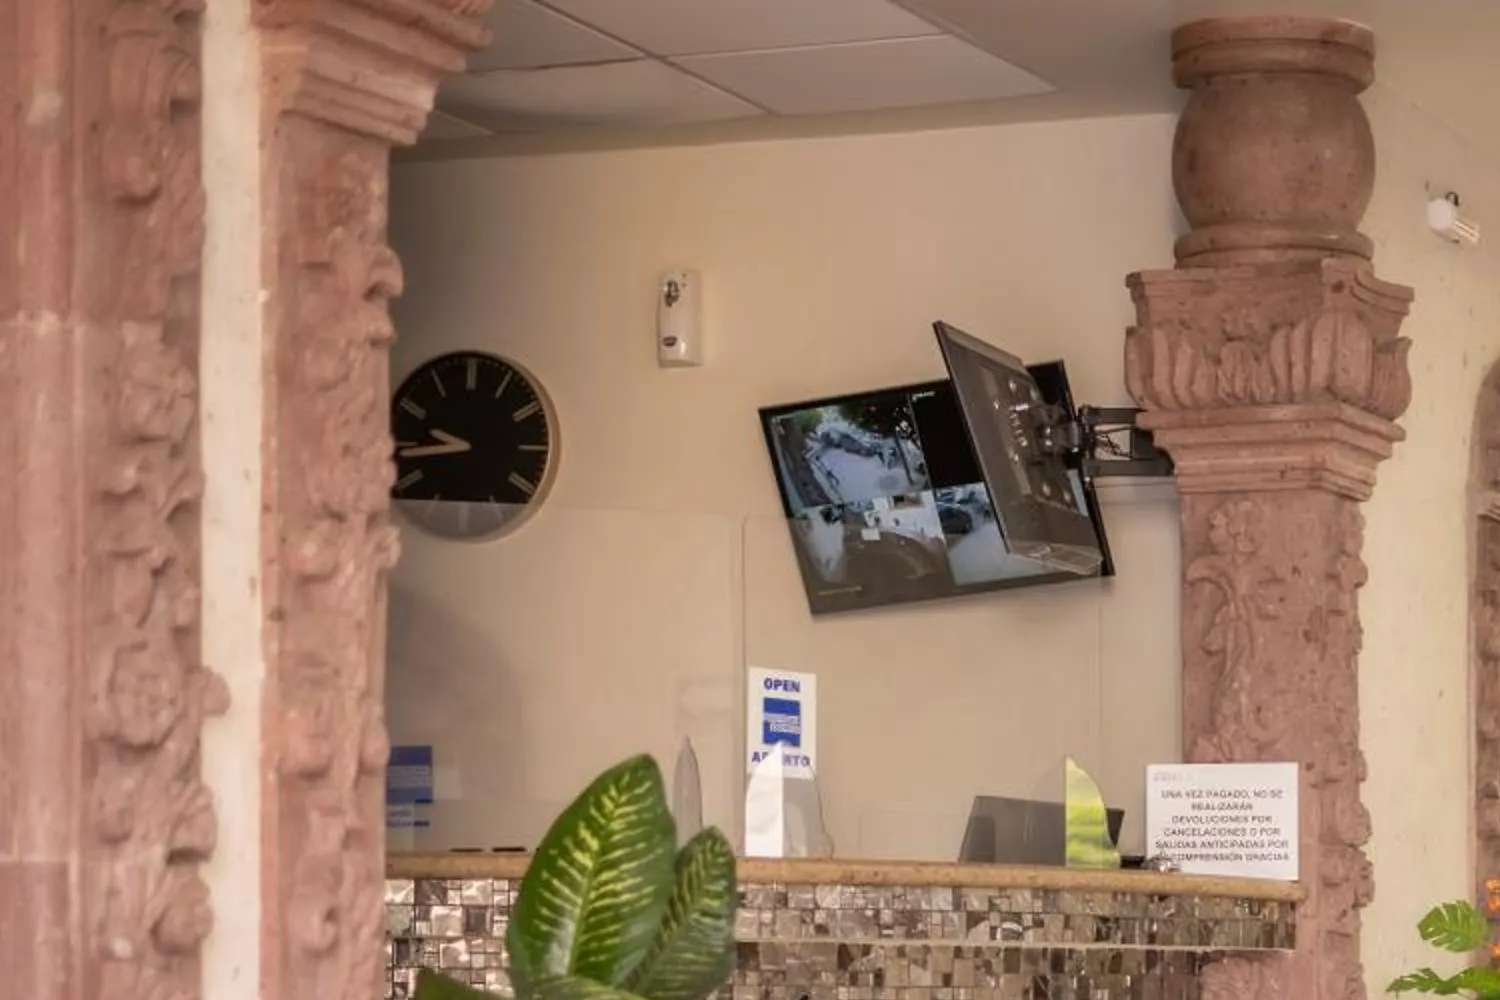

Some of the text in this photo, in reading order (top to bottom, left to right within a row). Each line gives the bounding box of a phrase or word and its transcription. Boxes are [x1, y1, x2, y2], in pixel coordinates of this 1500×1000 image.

[763, 678, 800, 692] OPEN
[752, 752, 810, 767] ARTO
[1161, 789, 1183, 799] UNA
[1185, 789, 1203, 799] VEZ
[1254, 789, 1269, 799] NO
[1251, 815, 1272, 825] POR
[1163, 827, 1247, 837] CANCELACIONES
[1260, 827, 1281, 837] POR
[1155, 840, 1289, 850] SALIDAS ANTICIPADAS POR
